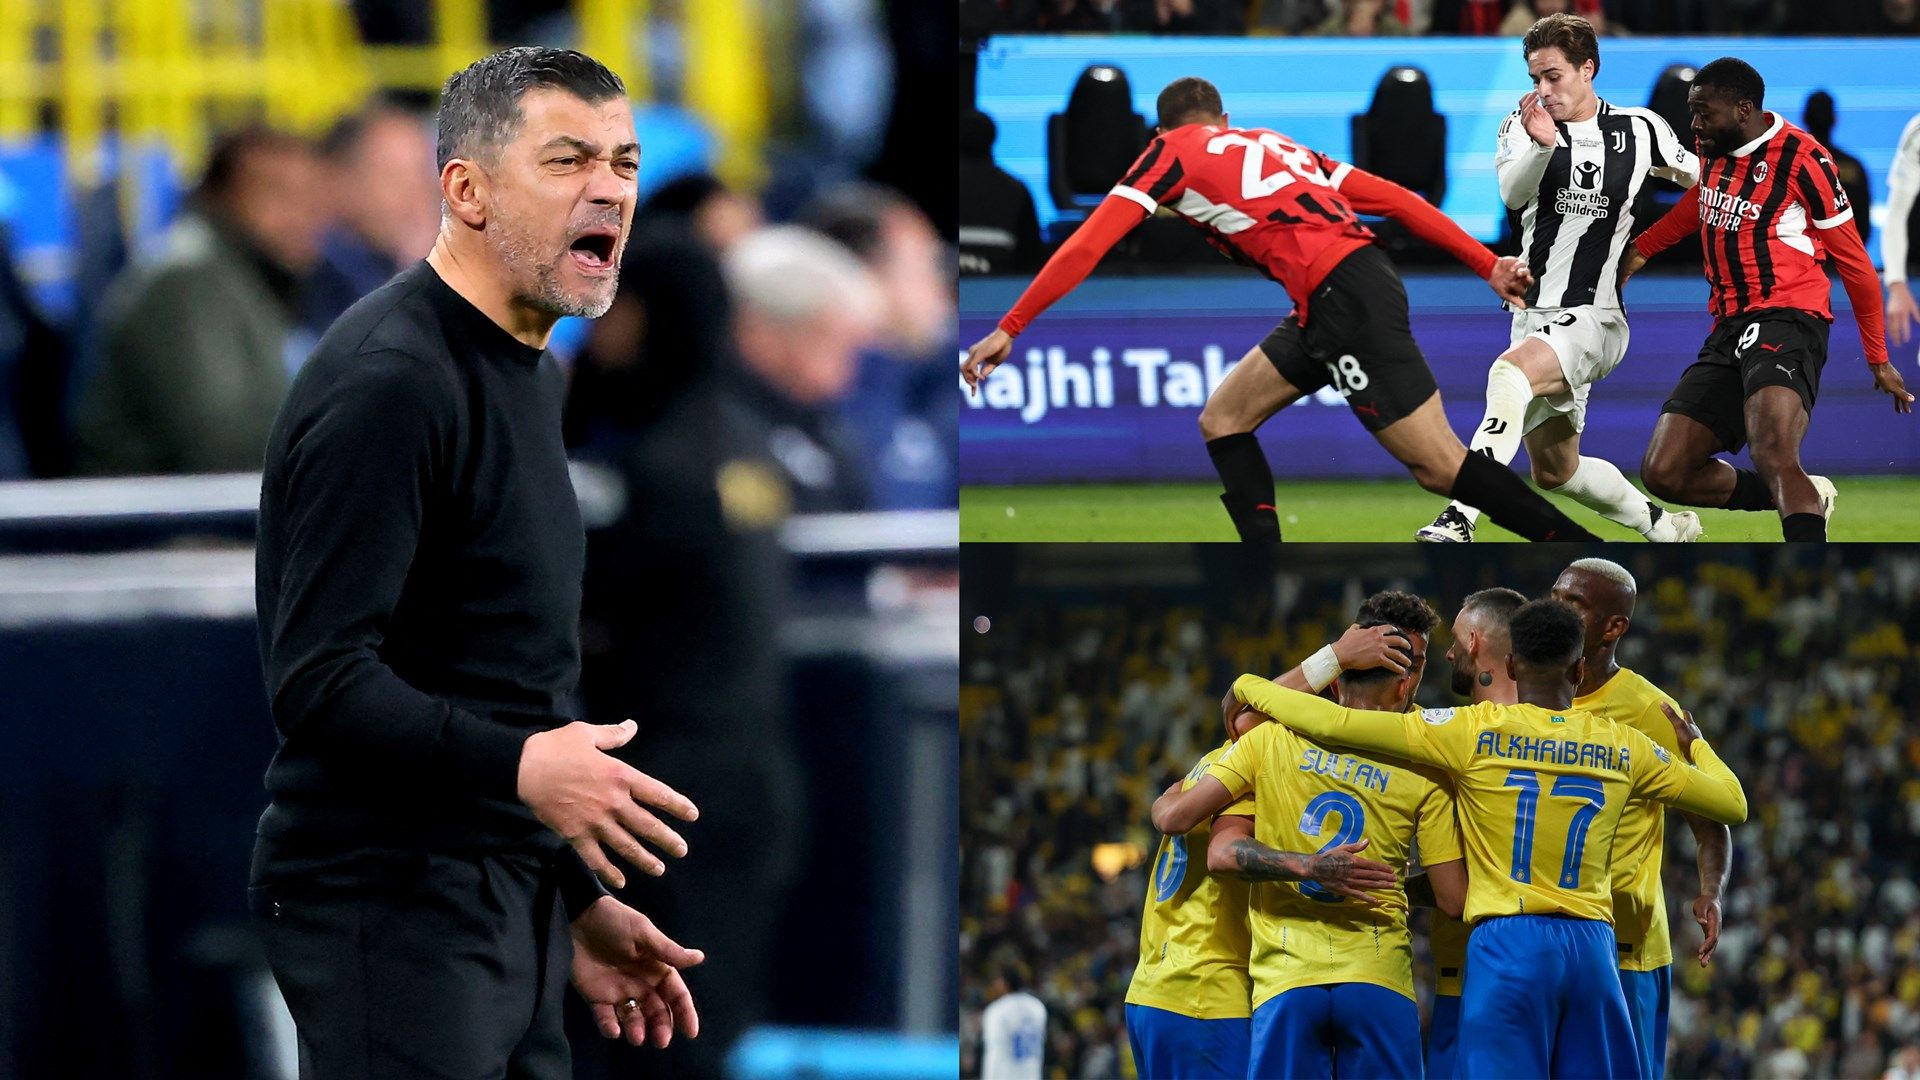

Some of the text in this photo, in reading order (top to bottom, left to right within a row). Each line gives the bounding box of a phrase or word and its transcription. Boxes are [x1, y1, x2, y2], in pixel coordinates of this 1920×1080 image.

[1206, 132, 1331, 200] 28
[1555, 201, 1608, 218] Children
[1556, 189, 1609, 206] Save the
[1699, 181, 1762, 220] mirates
[1299, 748, 1391, 794] SULTAN
[1476, 731, 1630, 772] ALKHAIBARI.A
[1298, 790, 1365, 903] 2
[1503, 769, 1606, 889] 17
